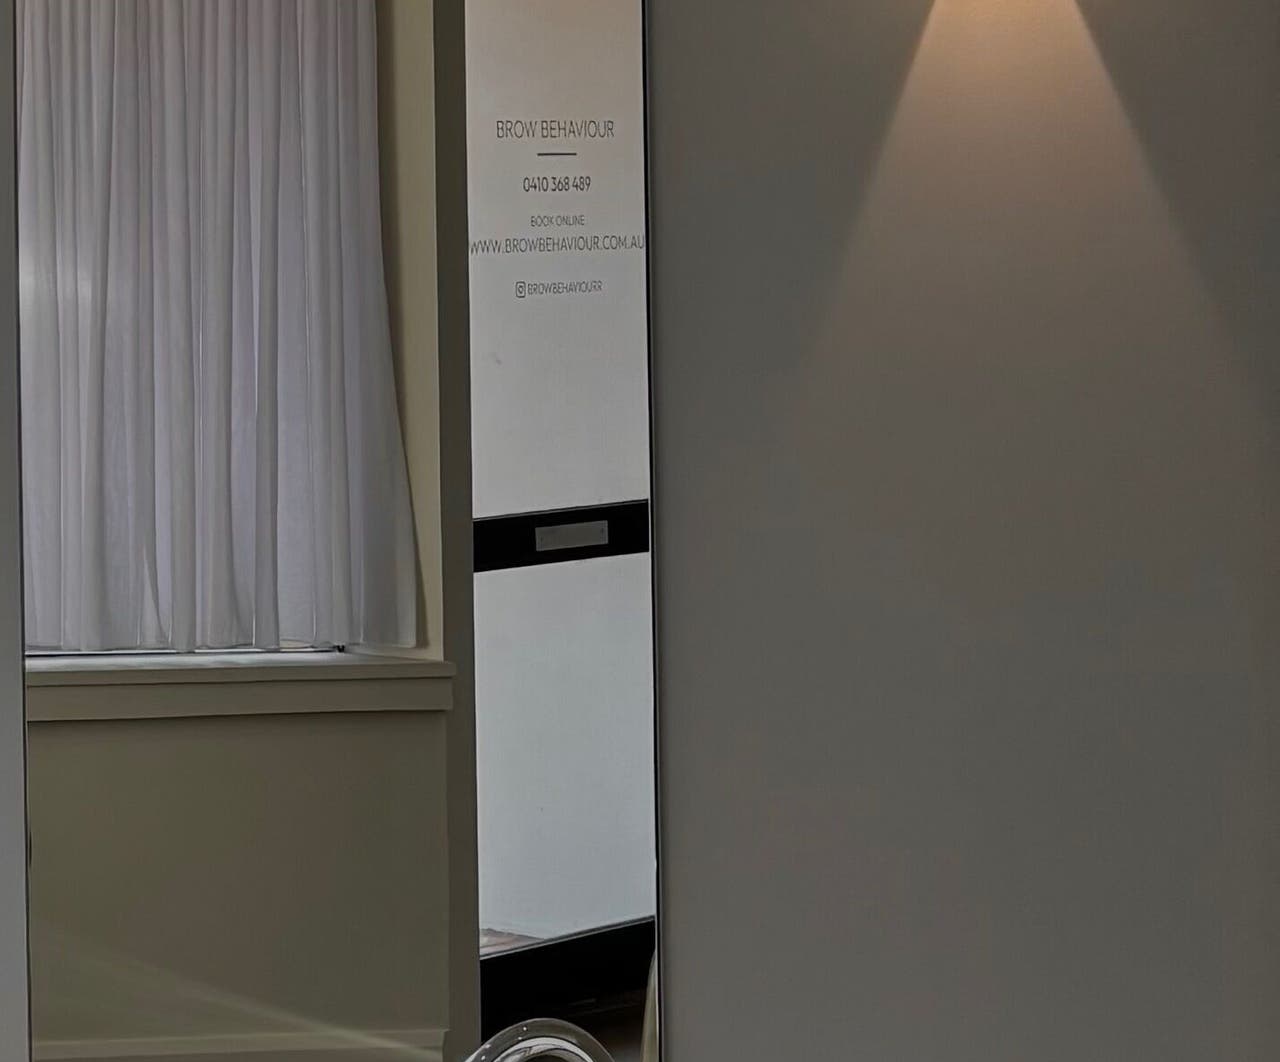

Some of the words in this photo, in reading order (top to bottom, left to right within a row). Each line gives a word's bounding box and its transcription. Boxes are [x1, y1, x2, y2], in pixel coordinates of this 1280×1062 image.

[496, 120, 537, 138] BROW
[541, 120, 615, 138] BEHAVIOUR
[523, 176, 549, 192] 0410
[551, 176, 570, 192] 368
[572, 176, 591, 191] 489
[530, 215, 554, 227] BOOK
[556, 214, 585, 227] ONLINE
